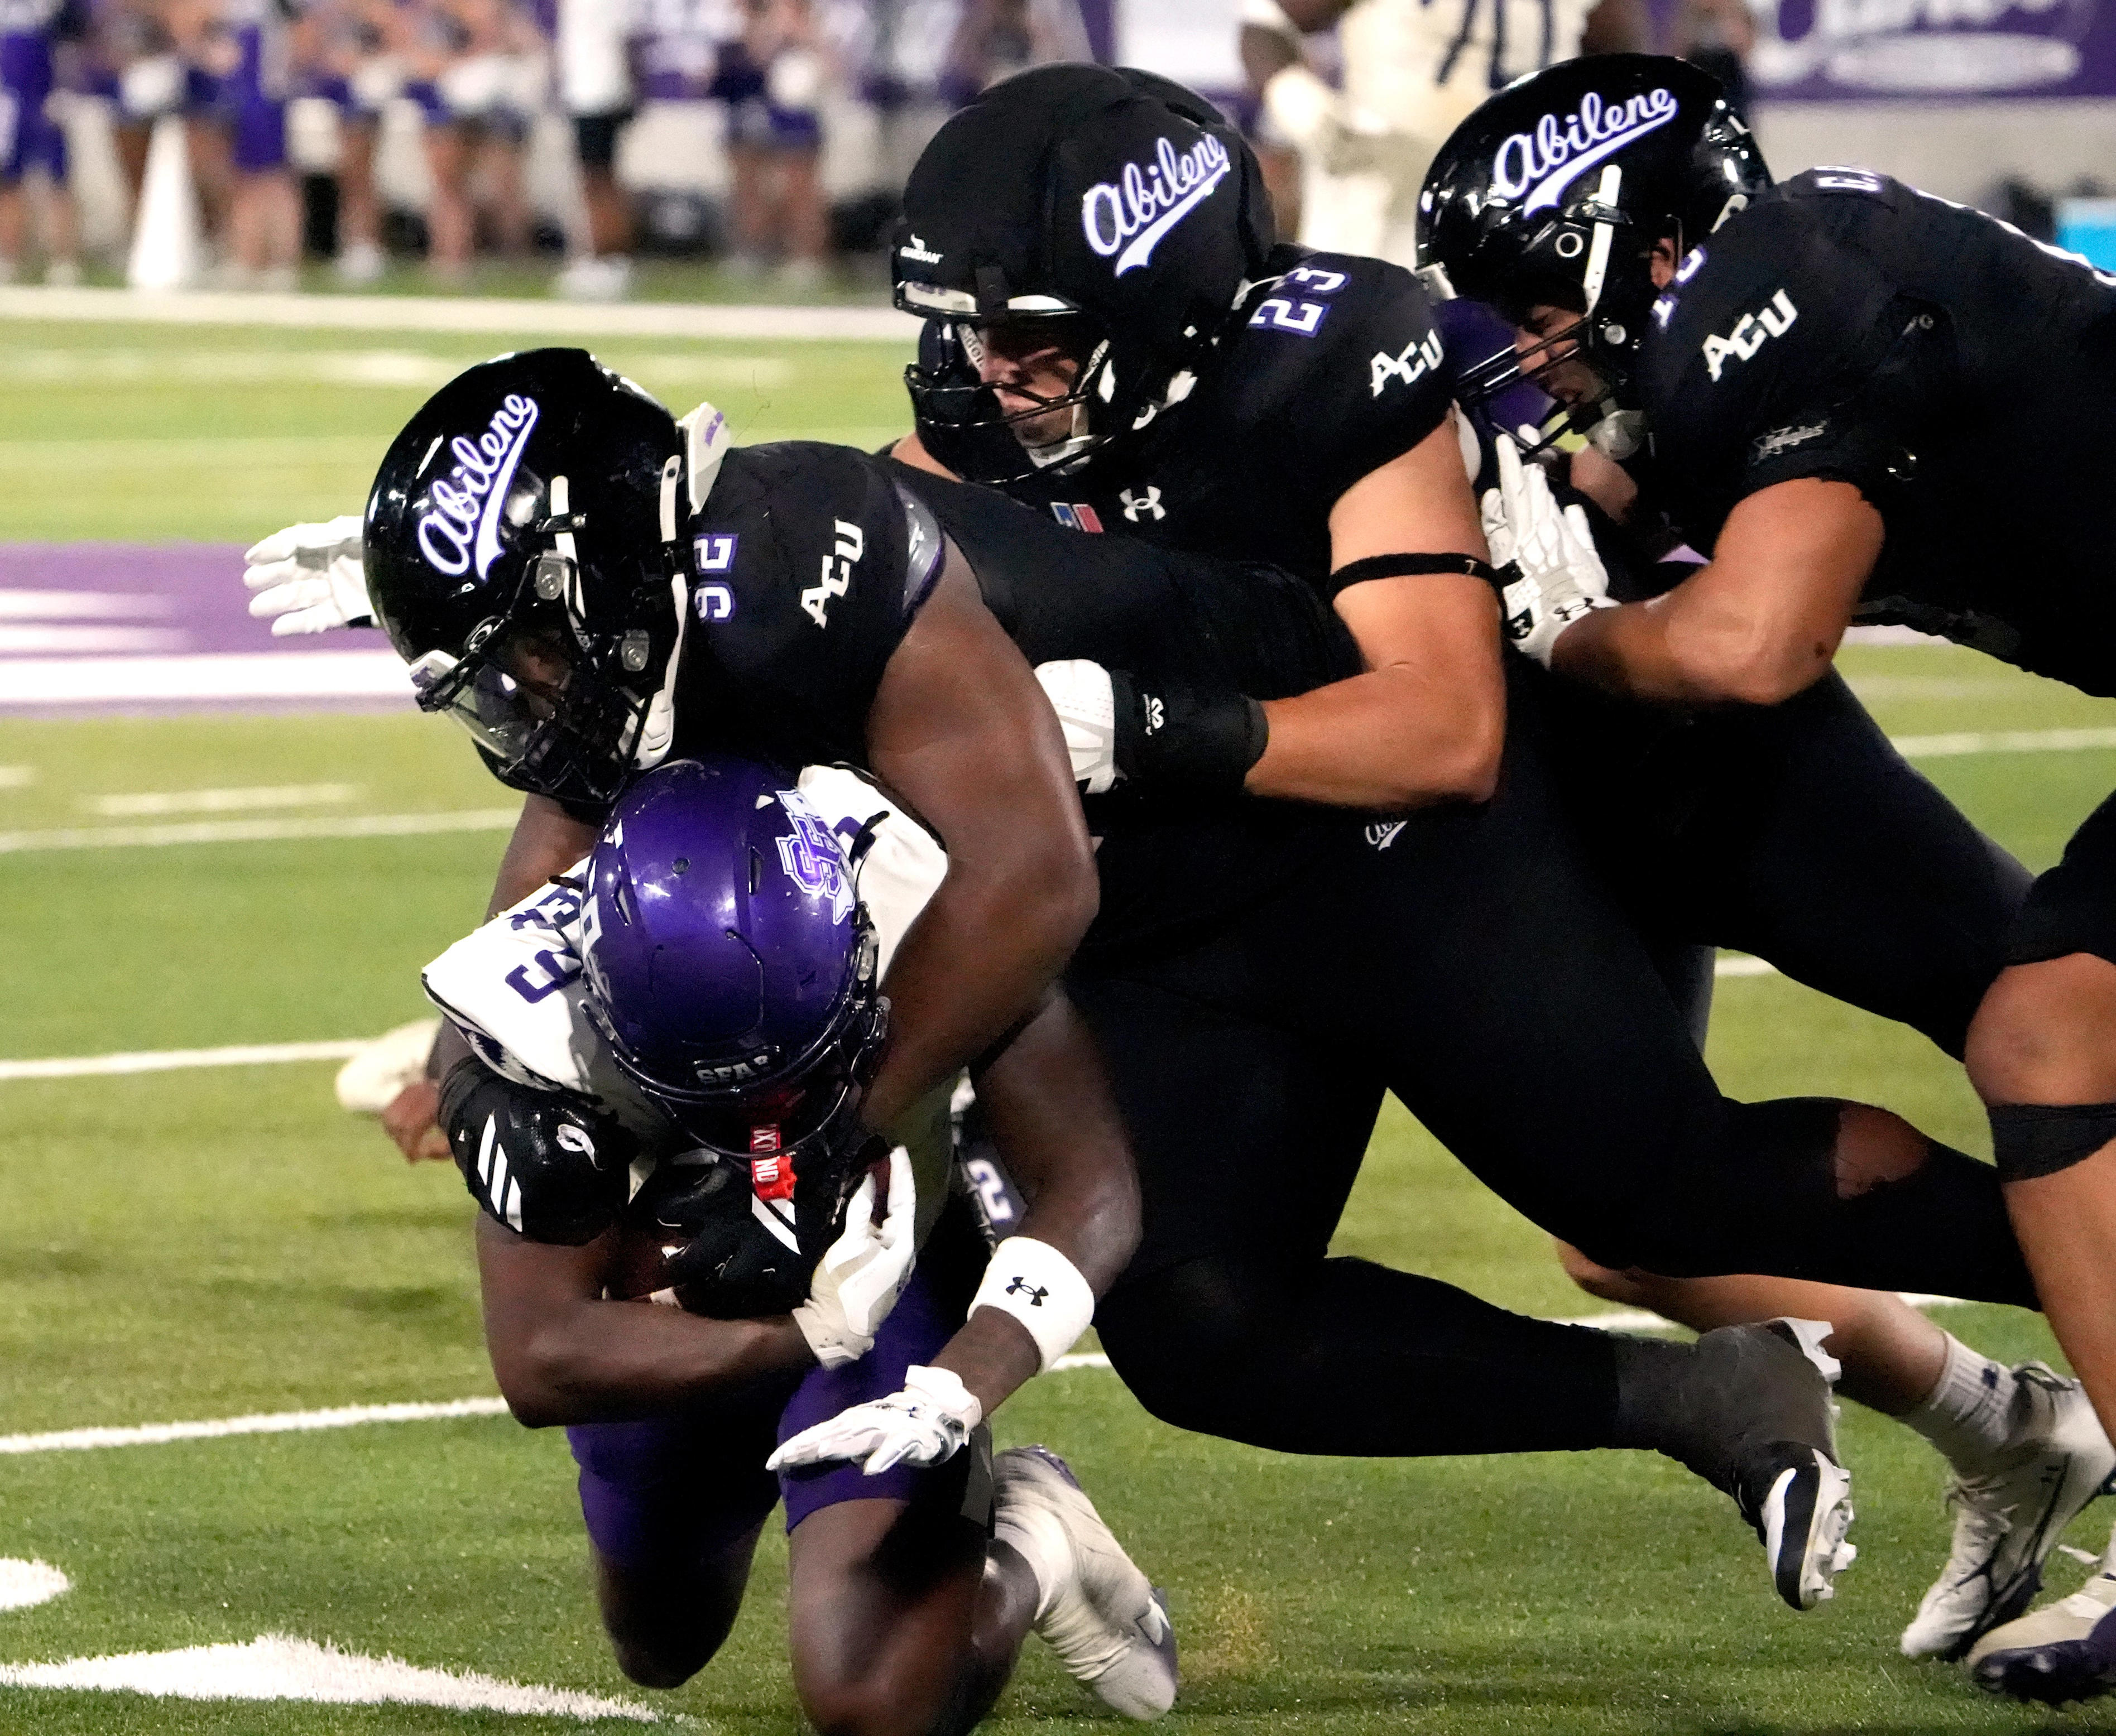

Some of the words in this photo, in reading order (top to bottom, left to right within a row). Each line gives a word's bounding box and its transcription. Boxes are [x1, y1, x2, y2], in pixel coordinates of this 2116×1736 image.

[1494, 88, 1677, 219] Abilene
[1082, 133, 1230, 278] Abilene
[1247, 267, 1350, 337] 23
[1702, 288, 1798, 383] ACU
[1369, 328, 1445, 398] ACU
[418, 393, 540, 581] Abilene
[693, 534, 737, 622] 92
[800, 520, 864, 629] ACU
